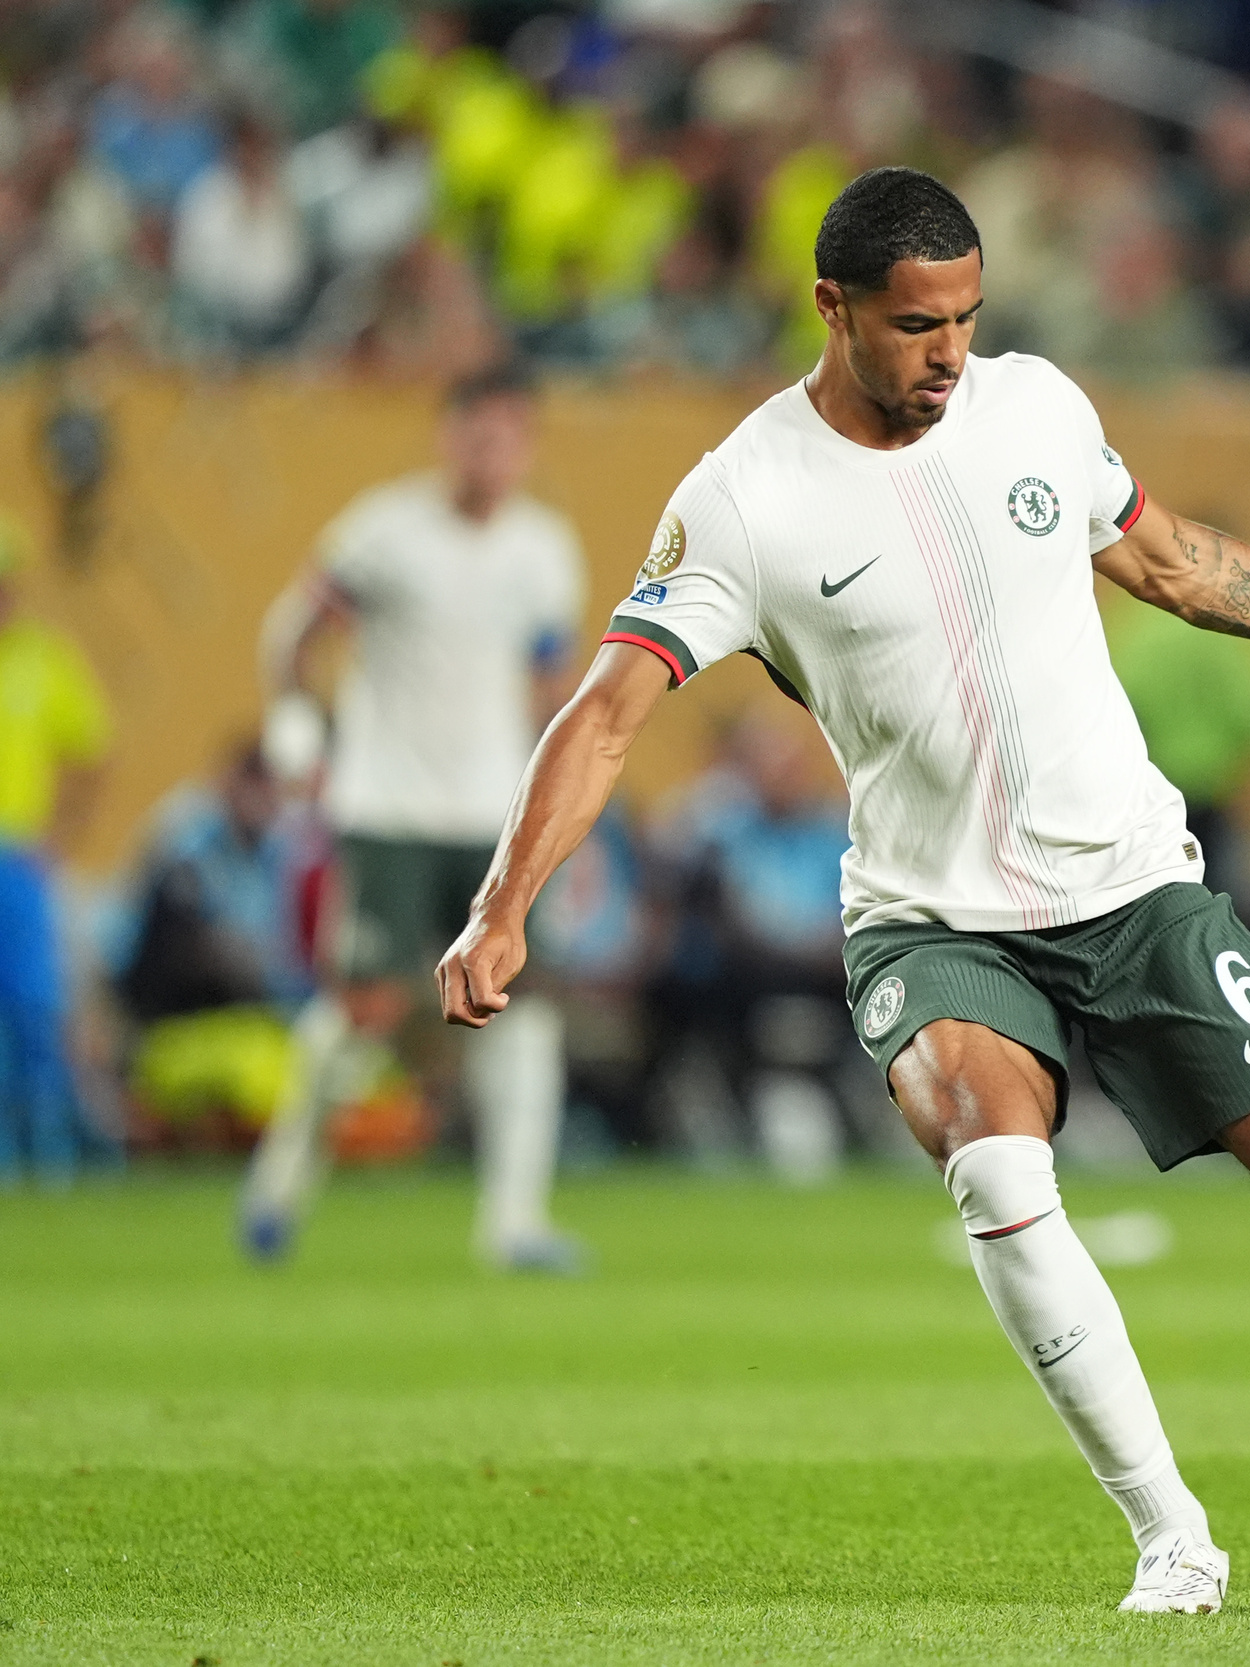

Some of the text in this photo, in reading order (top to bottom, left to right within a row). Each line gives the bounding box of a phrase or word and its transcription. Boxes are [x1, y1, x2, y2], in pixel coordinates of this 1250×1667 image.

[1011, 478, 1045, 496] CHELSEA
[1023, 526, 1048, 535] FOOTBALL
[662, 520, 680, 568] CUP 25 USA
[643, 561, 659, 575] FIFA
[1033, 1325, 1085, 1354] CFC
